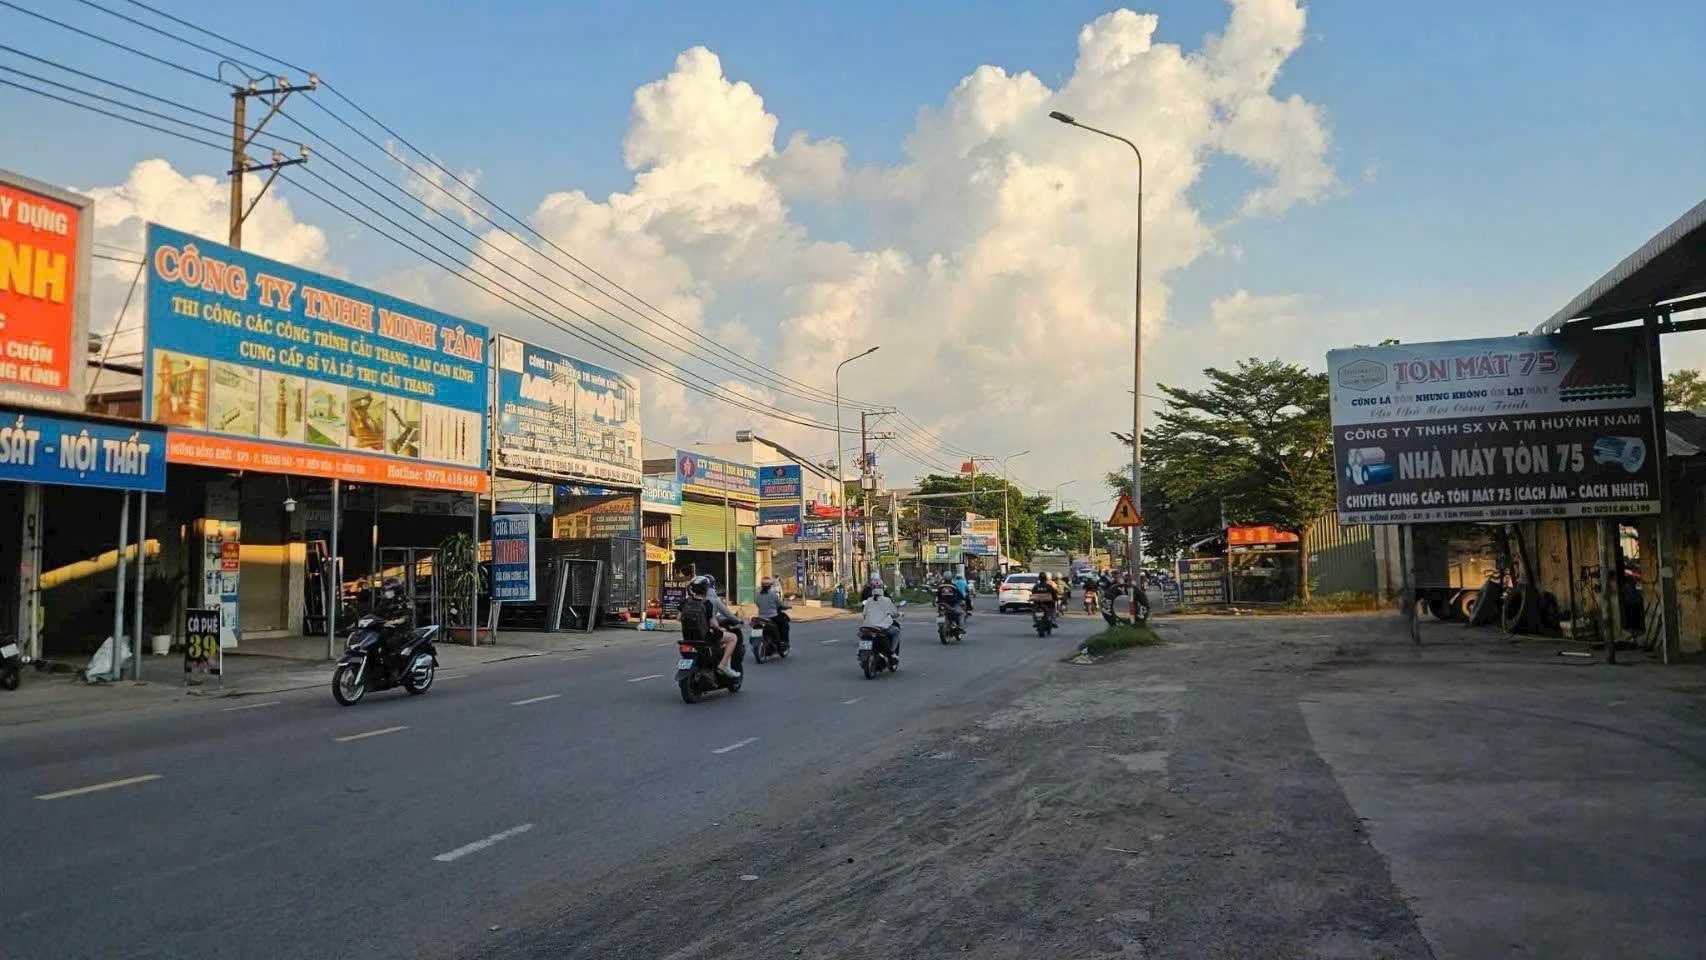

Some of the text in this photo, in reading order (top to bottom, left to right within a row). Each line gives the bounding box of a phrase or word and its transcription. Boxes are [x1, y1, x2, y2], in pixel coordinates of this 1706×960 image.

[17, 201, 68, 236] DỰNG
[154, 243, 483, 363] CÔNG TY TNHH MINH TÂM
[172, 296, 199, 318] THI
[203, 302, 241, 328] CÔNG
[246, 313, 273, 335] CÁC
[276, 320, 310, 344] CÔNG
[313, 328, 348, 353] TRÌNH
[350, 335, 373, 358] CẦU
[413, 356, 432, 372] LAN
[433, 361, 451, 378] CAN
[452, 363, 474, 383] KÍNH
[20, 364, 60, 386] KÍNH
[240, 341, 275, 362] CUNG
[279, 345, 304, 368] CẤP
[322, 356, 339, 376] VÀ
[404, 378, 435, 396] THANG
[1393, 356, 1450, 385] TÔN
[1518, 350, 1560, 376] 75
[1380, 394, 1391, 404] LÀ
[1452, 389, 1487, 400] KHÔNG
[1344, 414, 1641, 442] CÔNG TY TNHH SX VÀ TM HUỲNH NAM
[0, 414, 40, 465] SẮT
[60, 428, 98, 479] NỘI
[103, 431, 150, 476] THẤT
[1397, 440, 1584, 480] NHÀ MÁY TÔN 75
[387, 465, 422, 480] Hotline:
[1346, 491, 1386, 509] CHUYÊN
[1389, 492, 1419, 507] CUNG
[1421, 488, 1445, 505] CẤP:
[1447, 488, 1470, 504] TÔN
[1498, 488, 1512, 502] 75
[1515, 484, 1546, 502] (CÁCH
[1550, 483, 1568, 499] ÂM
[1578, 481, 1608, 498] CÁCH
[1610, 480, 1649, 500] NHIỆT)
[495, 519, 508, 536] CỬA
[187, 614, 219, 633] CÀ PHÊ
[188, 634, 217, 658] 39
